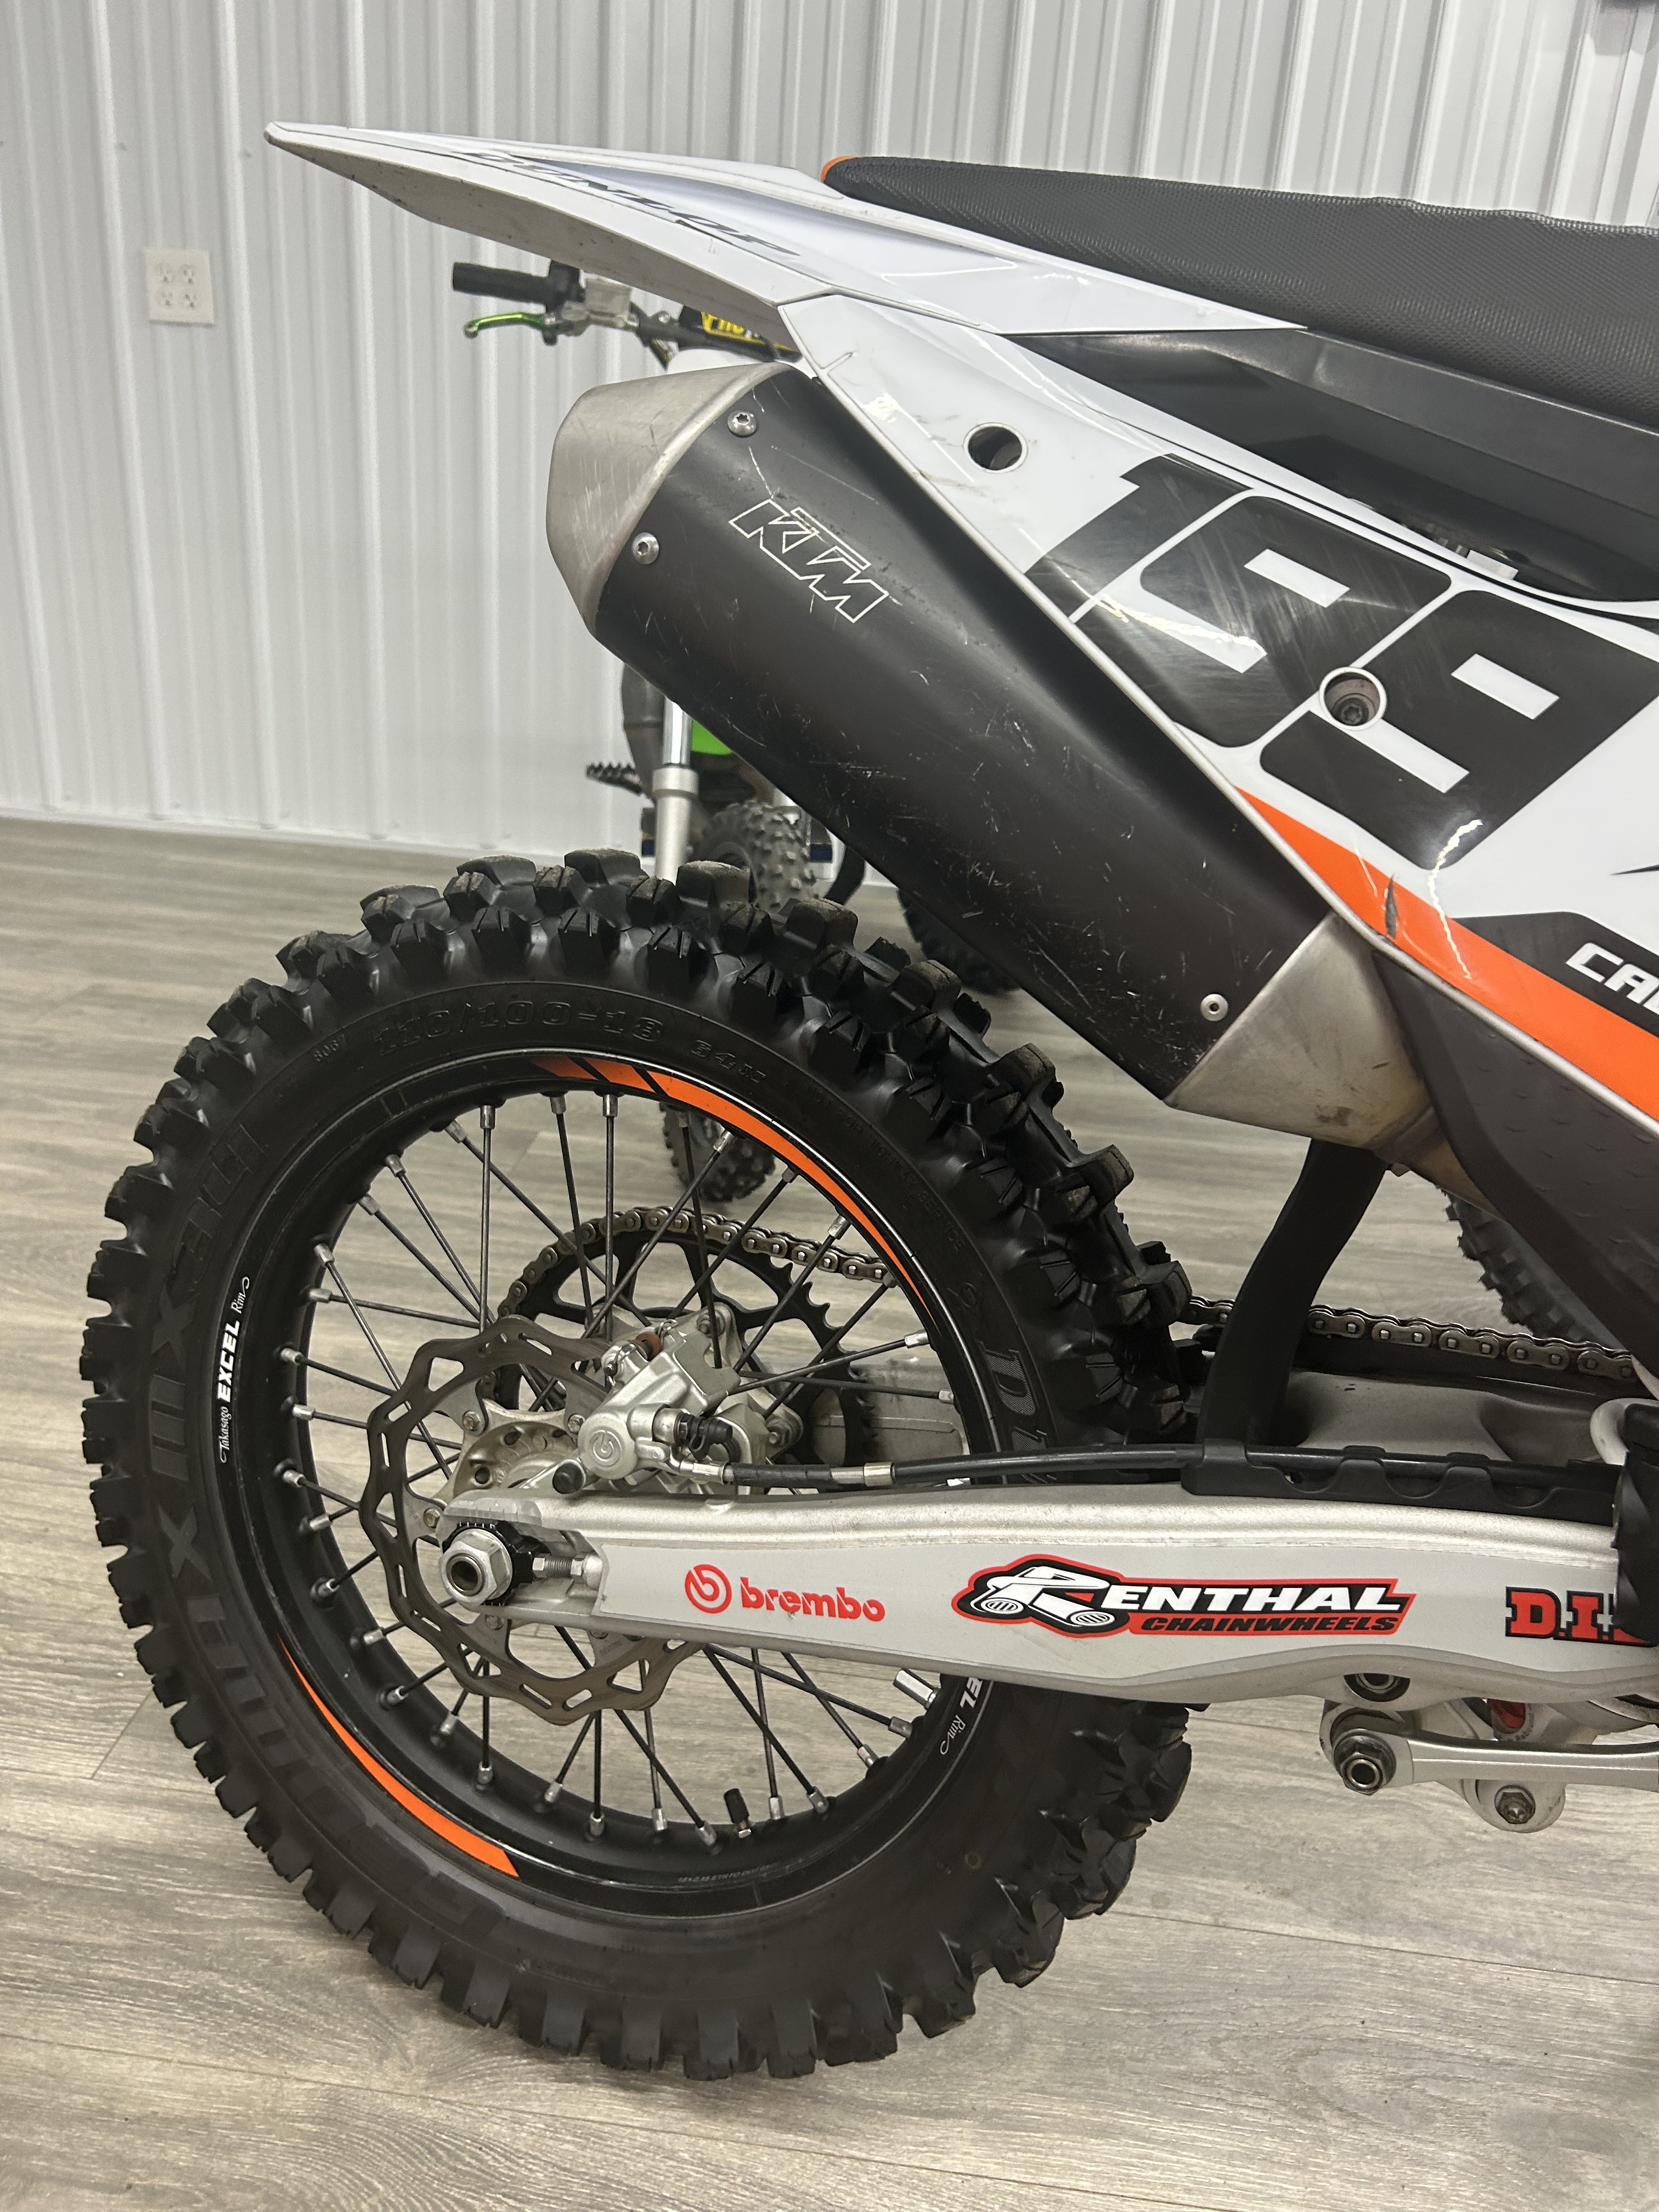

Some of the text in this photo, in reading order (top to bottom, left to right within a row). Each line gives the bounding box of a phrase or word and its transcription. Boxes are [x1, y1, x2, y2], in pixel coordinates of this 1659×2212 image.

[728, 498, 889, 624] KTM
[1565, 942, 1659, 1016] CA
[373, 999, 663, 1057] 110/100-18
[217, 1276, 250, 1464] Takasago EXCEL Rim
[740, 1577, 885, 1622] brembo
[1141, 1616, 1398, 1632] CHAINWHEELS
[940, 1714, 966, 1755] Rim
